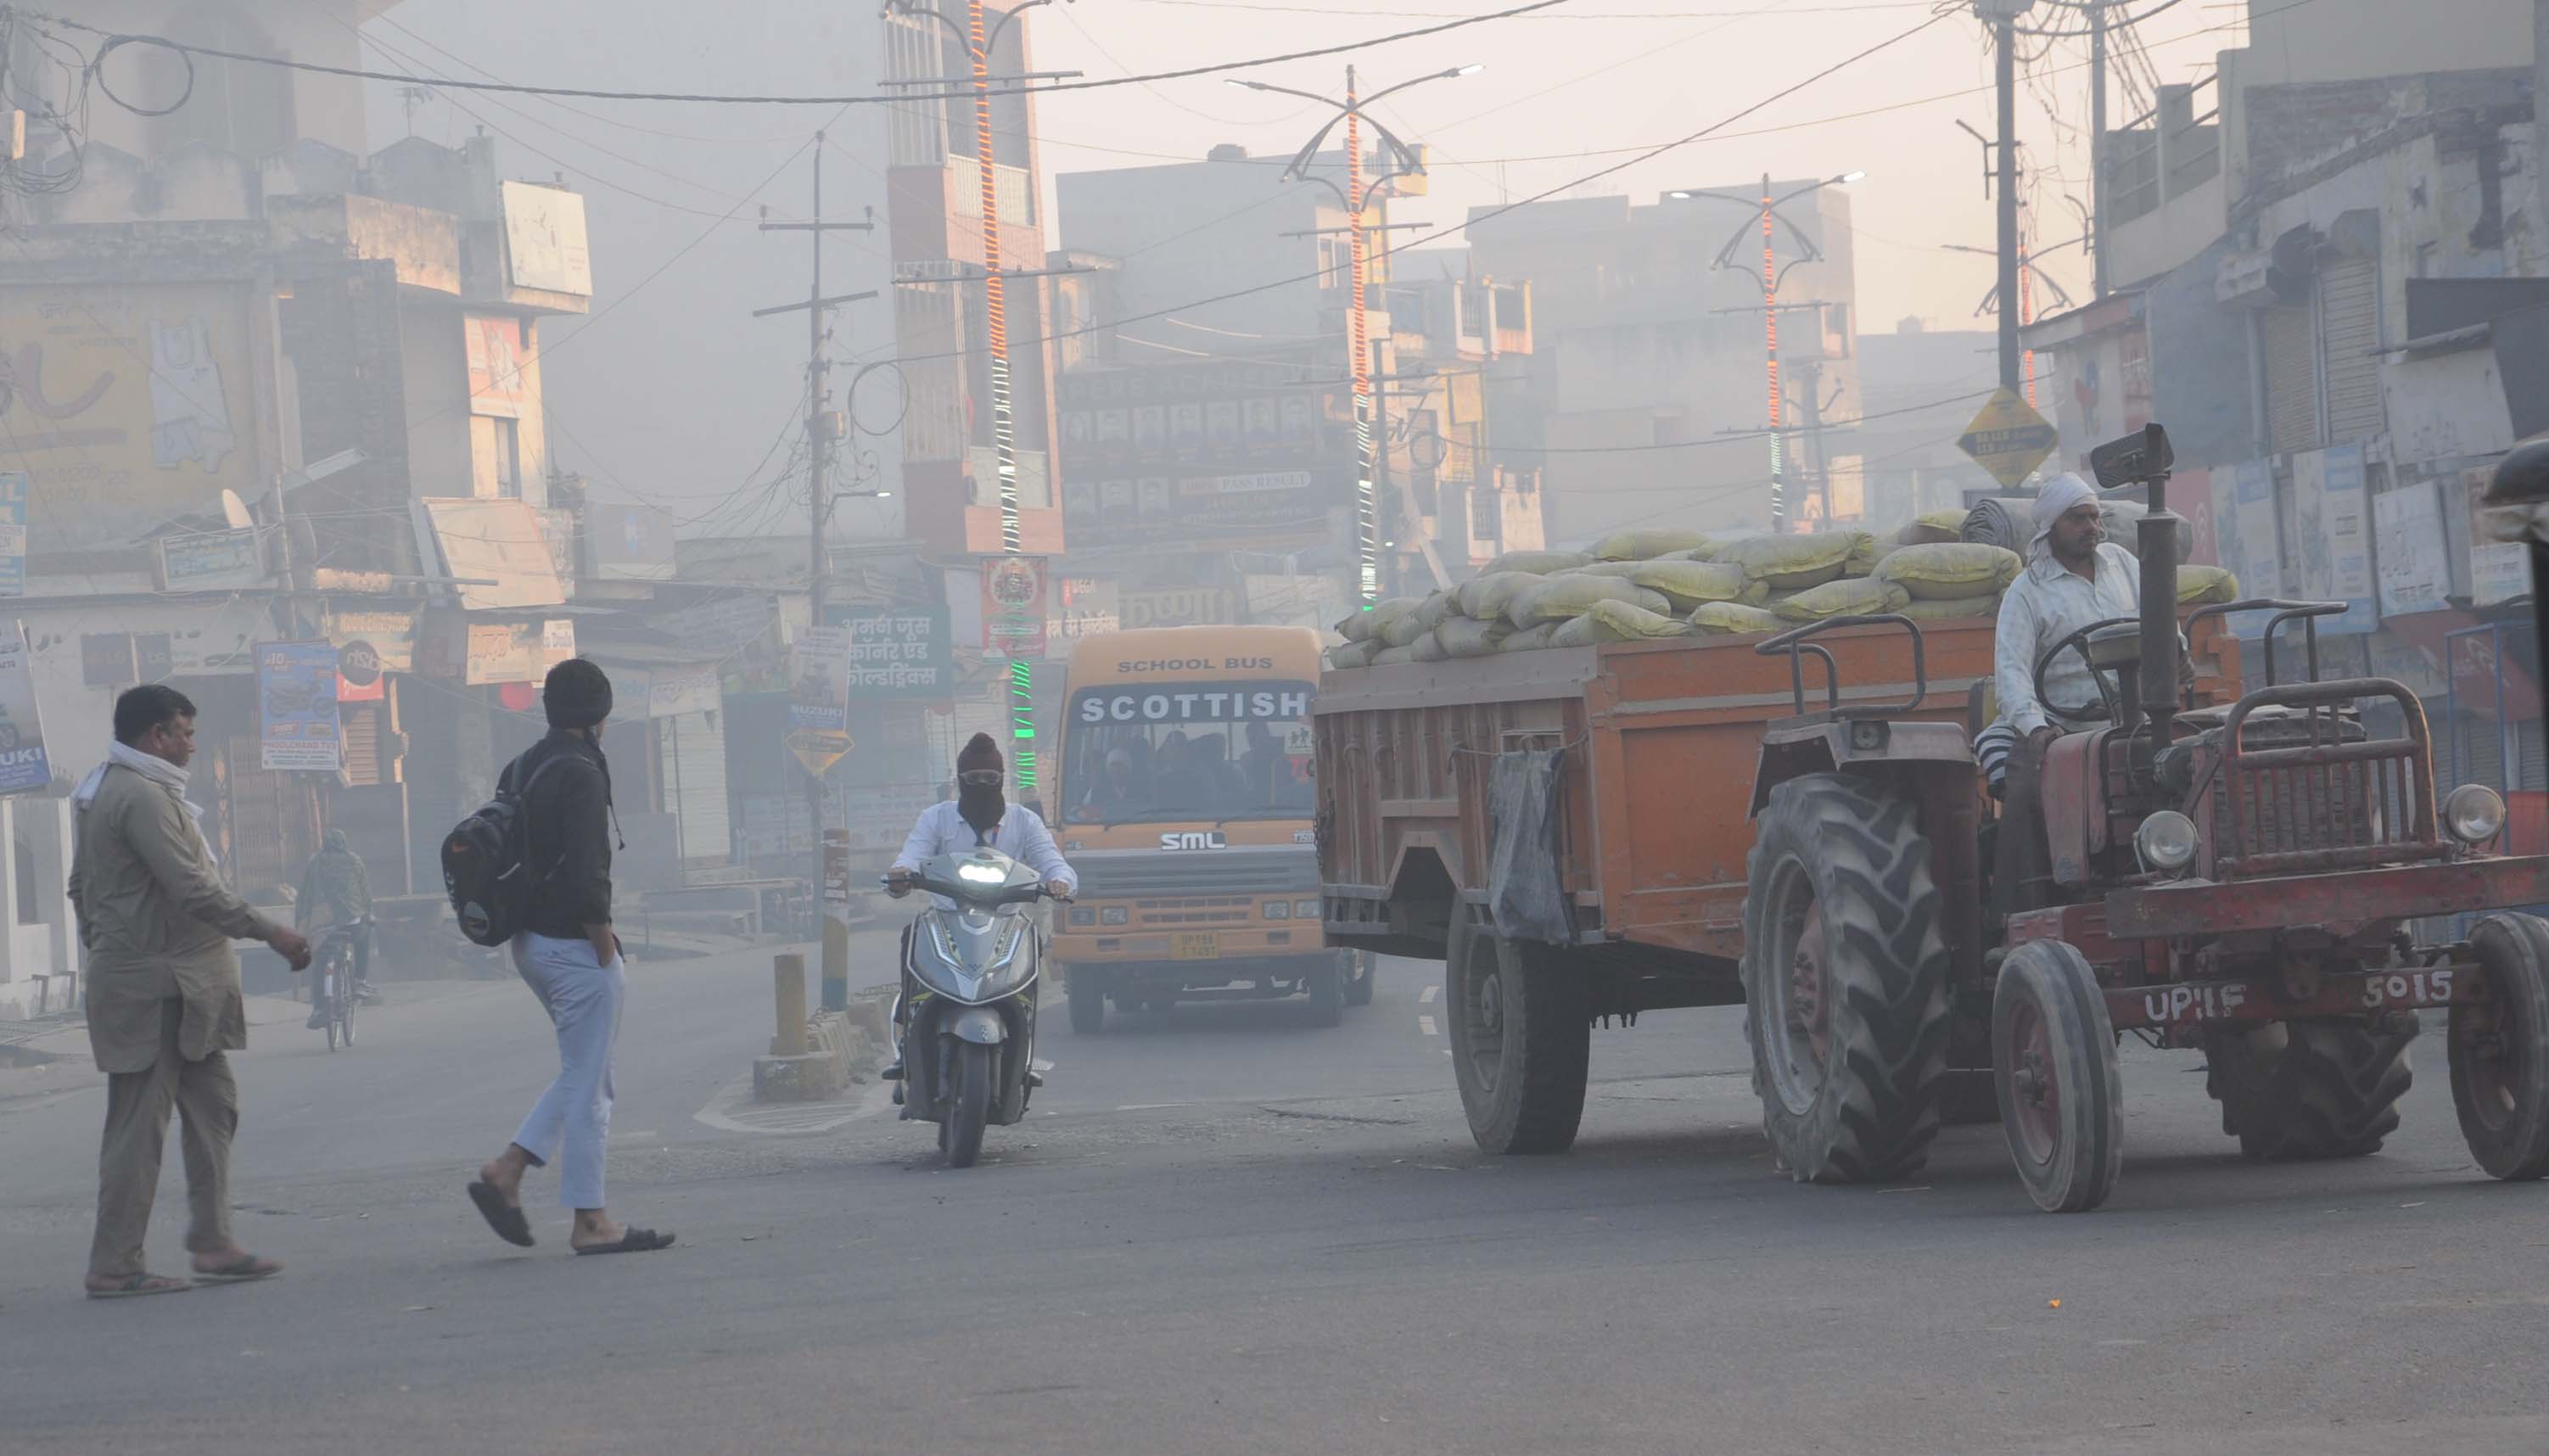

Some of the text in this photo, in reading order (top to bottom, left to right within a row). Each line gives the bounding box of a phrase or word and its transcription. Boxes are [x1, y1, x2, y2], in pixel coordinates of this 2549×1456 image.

[895, 616, 933, 641] जूस
[1116, 657, 1274, 674] SCHOOL BUS
[791, 704, 843, 718] SUZUKI
[1081, 692, 1307, 723] SCOTTISH
[0, 748, 42, 765] UKI
[1161, 832, 1226, 850] SML
[2362, 971, 2453, 1009] 5015
